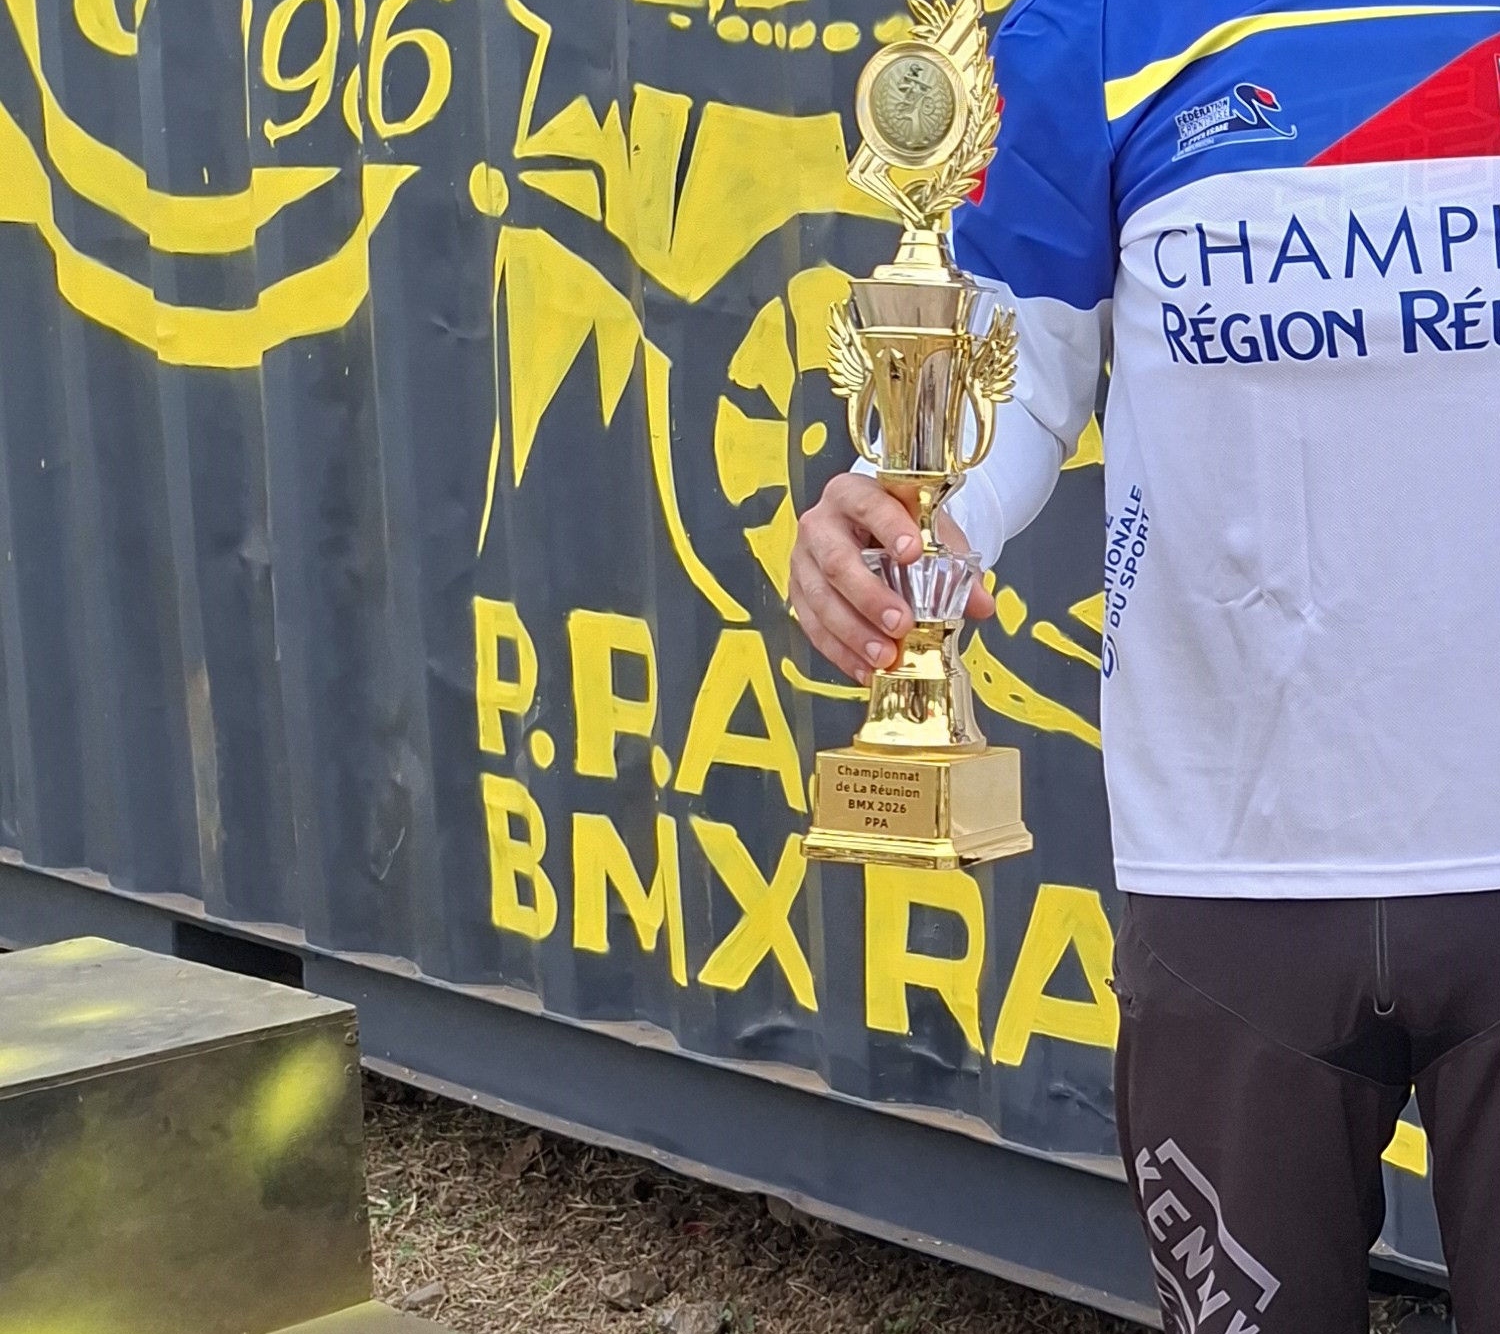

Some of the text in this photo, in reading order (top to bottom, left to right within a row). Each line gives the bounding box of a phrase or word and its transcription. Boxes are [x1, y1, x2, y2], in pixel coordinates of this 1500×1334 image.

[1161, 301, 1367, 364] RÉGION
[1110, 507, 1150, 628] DU SPORT
[837, 764, 920, 782] Championnat
[835, 781, 921, 799] de La Réunion
[848, 799, 908, 814] BMX 2026
[864, 816, 889, 829] PPA
[480, 772, 818, 1012] BMX
